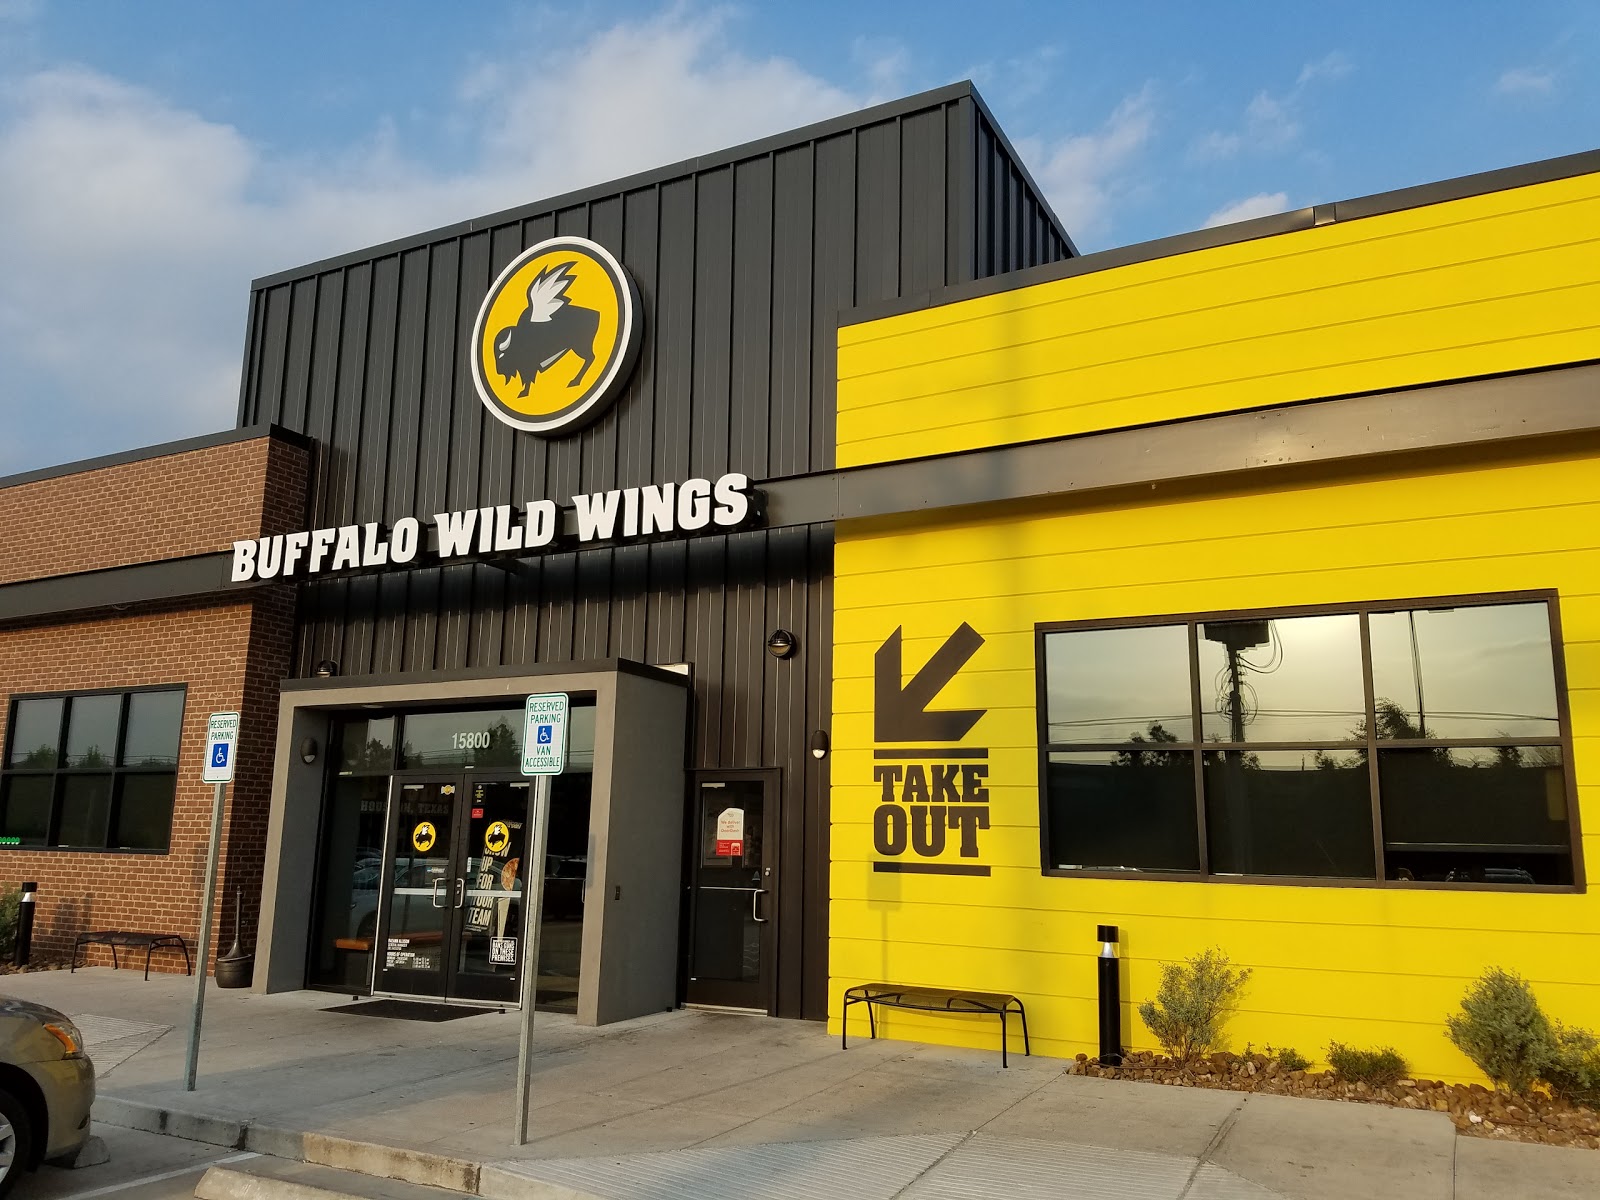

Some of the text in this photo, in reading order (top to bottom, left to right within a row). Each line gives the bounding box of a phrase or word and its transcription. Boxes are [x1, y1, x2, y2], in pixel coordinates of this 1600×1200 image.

[231, 473, 749, 582] BUFFALO WILD WINGS
[529, 701, 564, 713] RESERVED
[211, 719, 236, 728] RESERVED
[530, 713, 561, 724] PARKING
[211, 731, 233, 740] PARKING
[451, 731, 491, 749] 15800
[536, 745, 551, 756] VAN
[525, 756, 560, 768] ACCESSIBLE
[873, 764, 990, 803] TAKE
[418, 803, 449, 815] TEXAS
[873, 804, 990, 858] OUT
[481, 856, 493, 872] UP
[476, 872, 494, 890] FOR
[468, 907, 492, 927] TEAM
